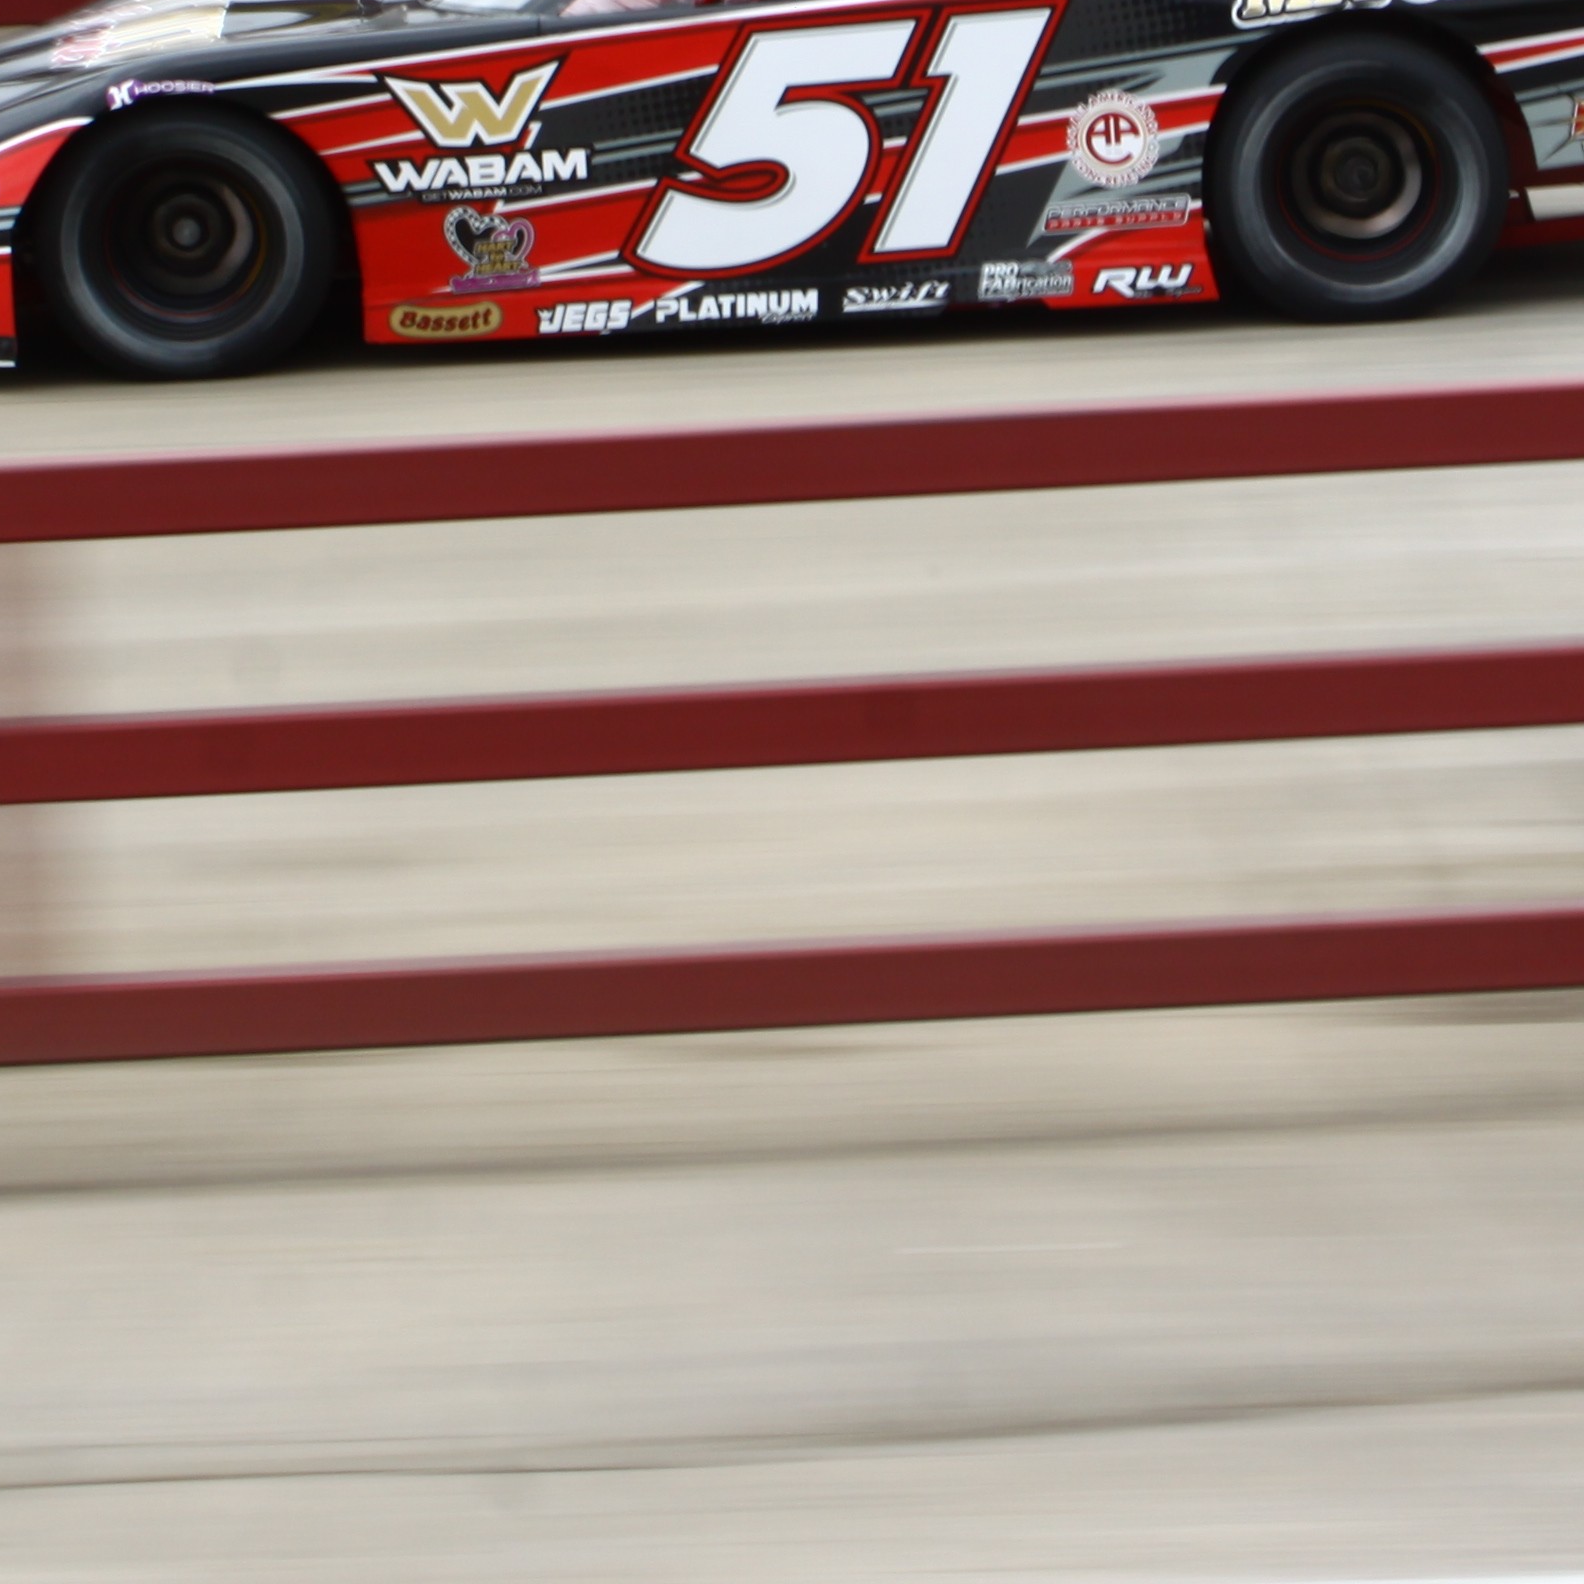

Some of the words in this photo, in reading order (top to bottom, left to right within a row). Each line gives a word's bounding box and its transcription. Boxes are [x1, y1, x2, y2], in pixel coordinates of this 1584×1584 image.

[135, 79, 214, 95] HOOSIER
[633, 5, 1056, 273] 51
[374, 147, 588, 193] WABAM
[983, 263, 1019, 276] PRO
[1092, 262, 1193, 299] RW
[399, 306, 493, 332] Bassett
[537, 299, 632, 334] JEGS
[654, 288, 819, 323] PLATINUM
